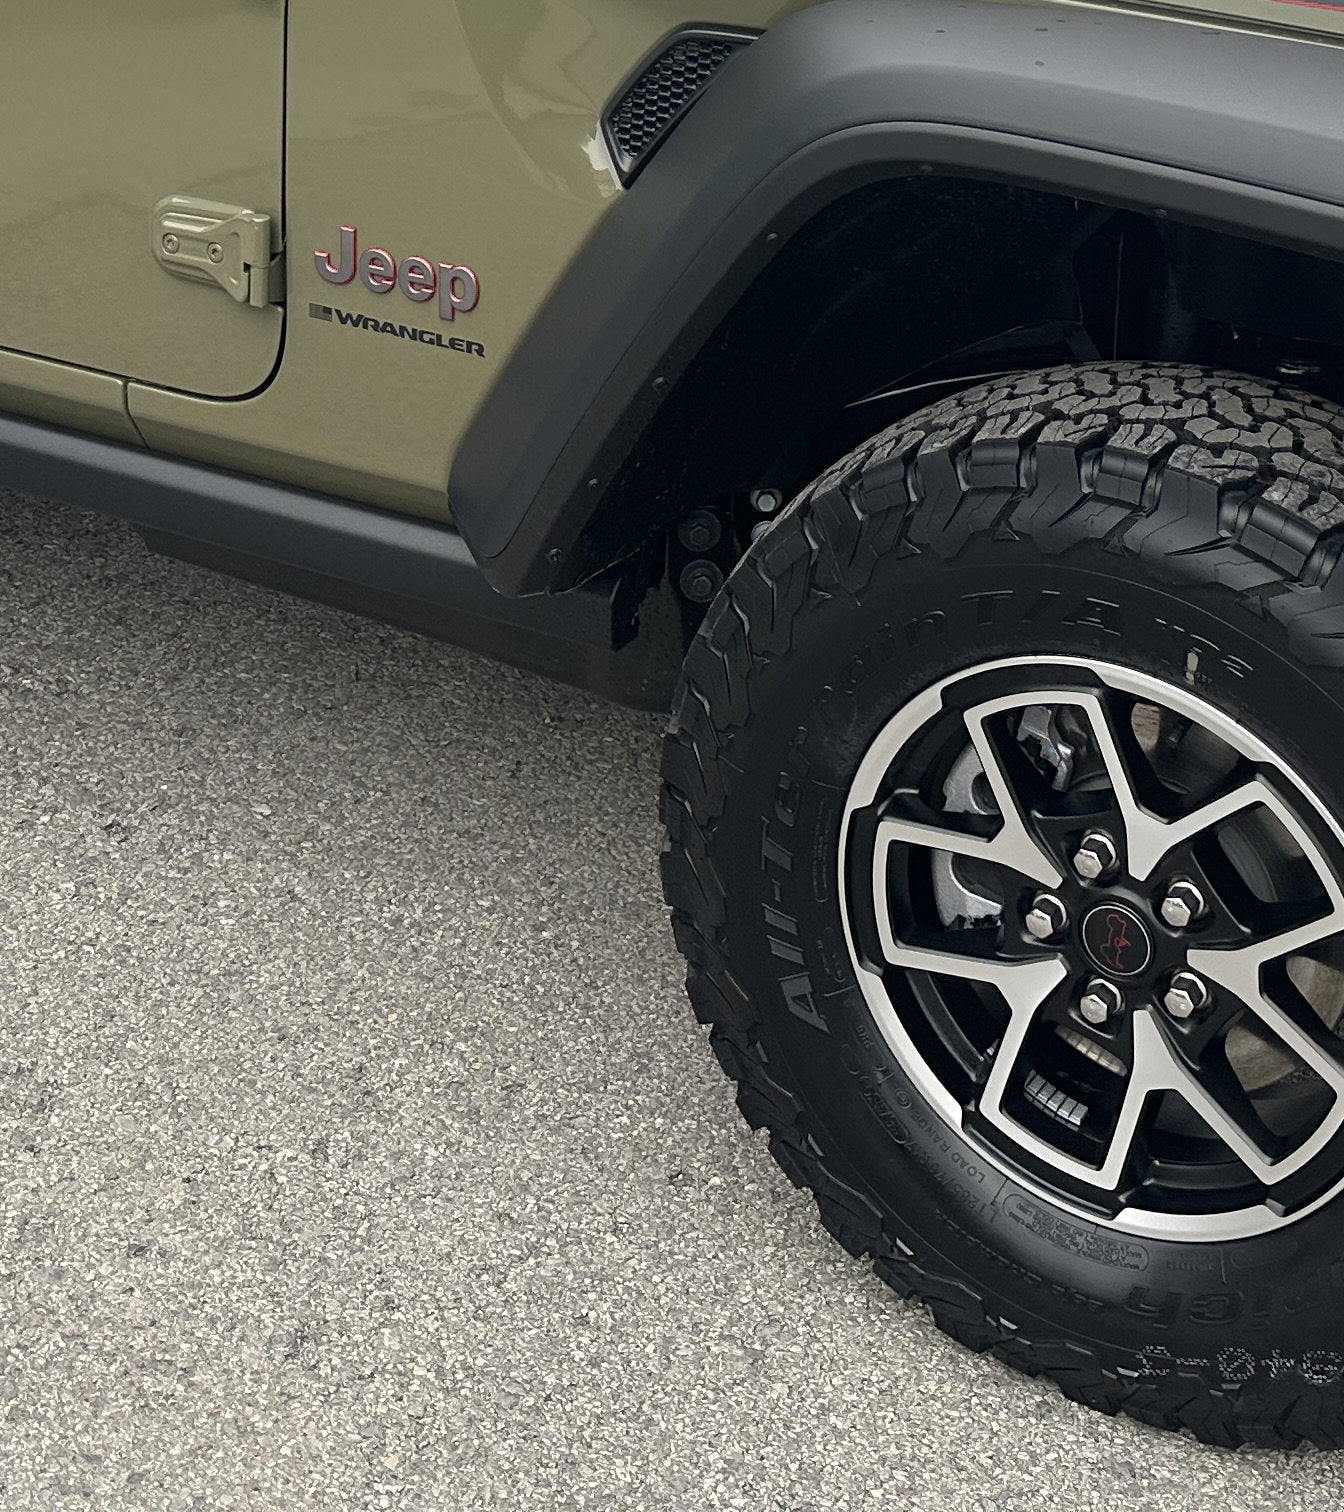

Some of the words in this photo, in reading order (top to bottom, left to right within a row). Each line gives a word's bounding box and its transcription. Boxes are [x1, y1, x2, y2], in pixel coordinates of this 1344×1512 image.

[314, 225, 480, 322] Jeep
[334, 307, 486, 359] WRANGLER
[960, 589, 1122, 638] T/A
[951, 1150, 986, 1185] LOAD
